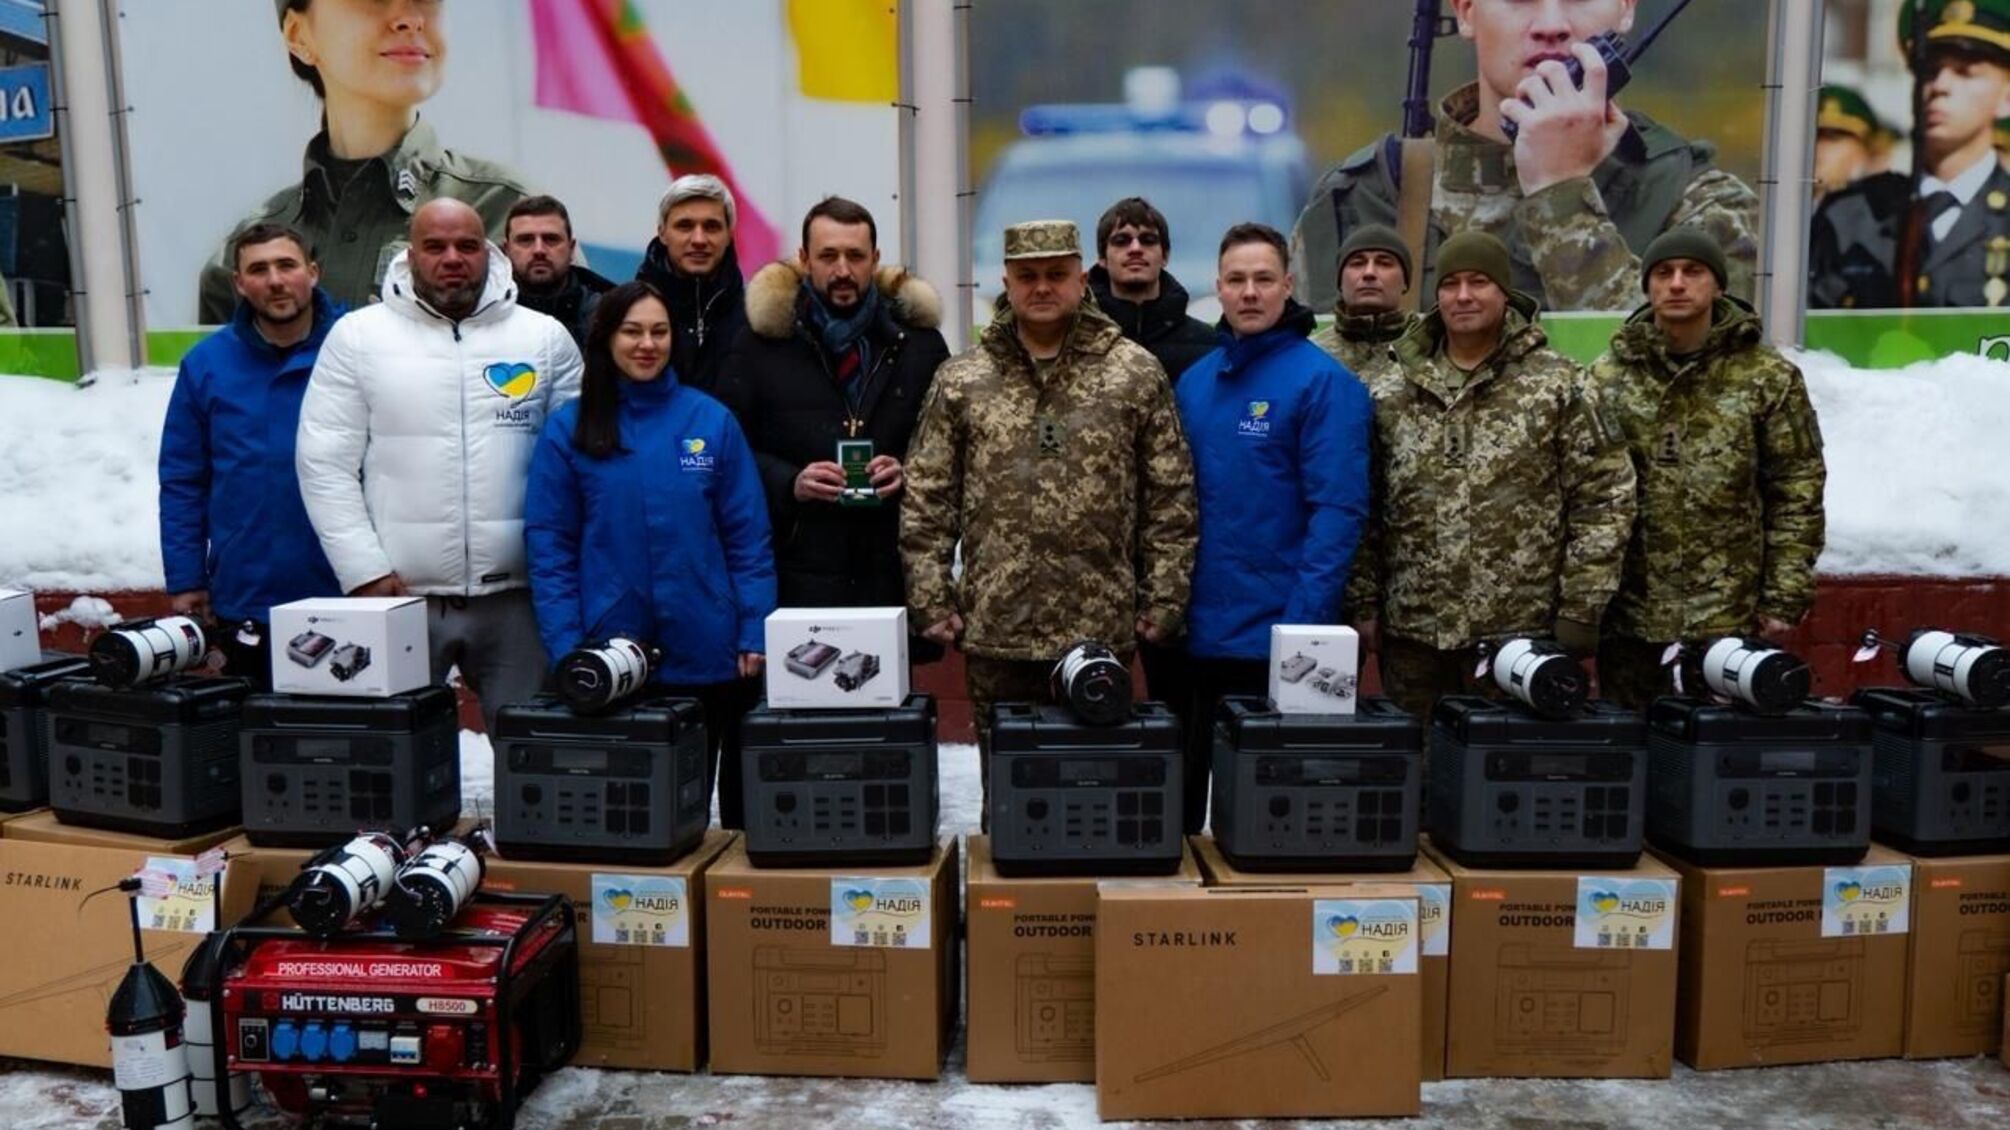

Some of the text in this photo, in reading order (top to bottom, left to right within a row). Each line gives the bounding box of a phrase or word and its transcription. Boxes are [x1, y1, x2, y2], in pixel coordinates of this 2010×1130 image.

[5, 872, 83, 891] STARLINK
[1862, 887, 1904, 900] НАДІЯ
[635, 898, 679, 911] НАДІЯ
[876, 899, 922, 912] НАДІЯ
[1620, 900, 1666, 914] НАДІЯ
[751, 917, 827, 930] OUTDOOR
[1499, 915, 1576, 928] OUTDOOR
[1746, 909, 1815, 925] OUTDOOR
[1014, 926, 1092, 937] OUTDOOR
[1361, 923, 1409, 937] НАДІЯ
[1133, 932, 1237, 947] STARLINK
[278, 962, 442, 977] PROFESSIONAL GENERATOR
[282, 992, 395, 1013] HÜTTENBERG
